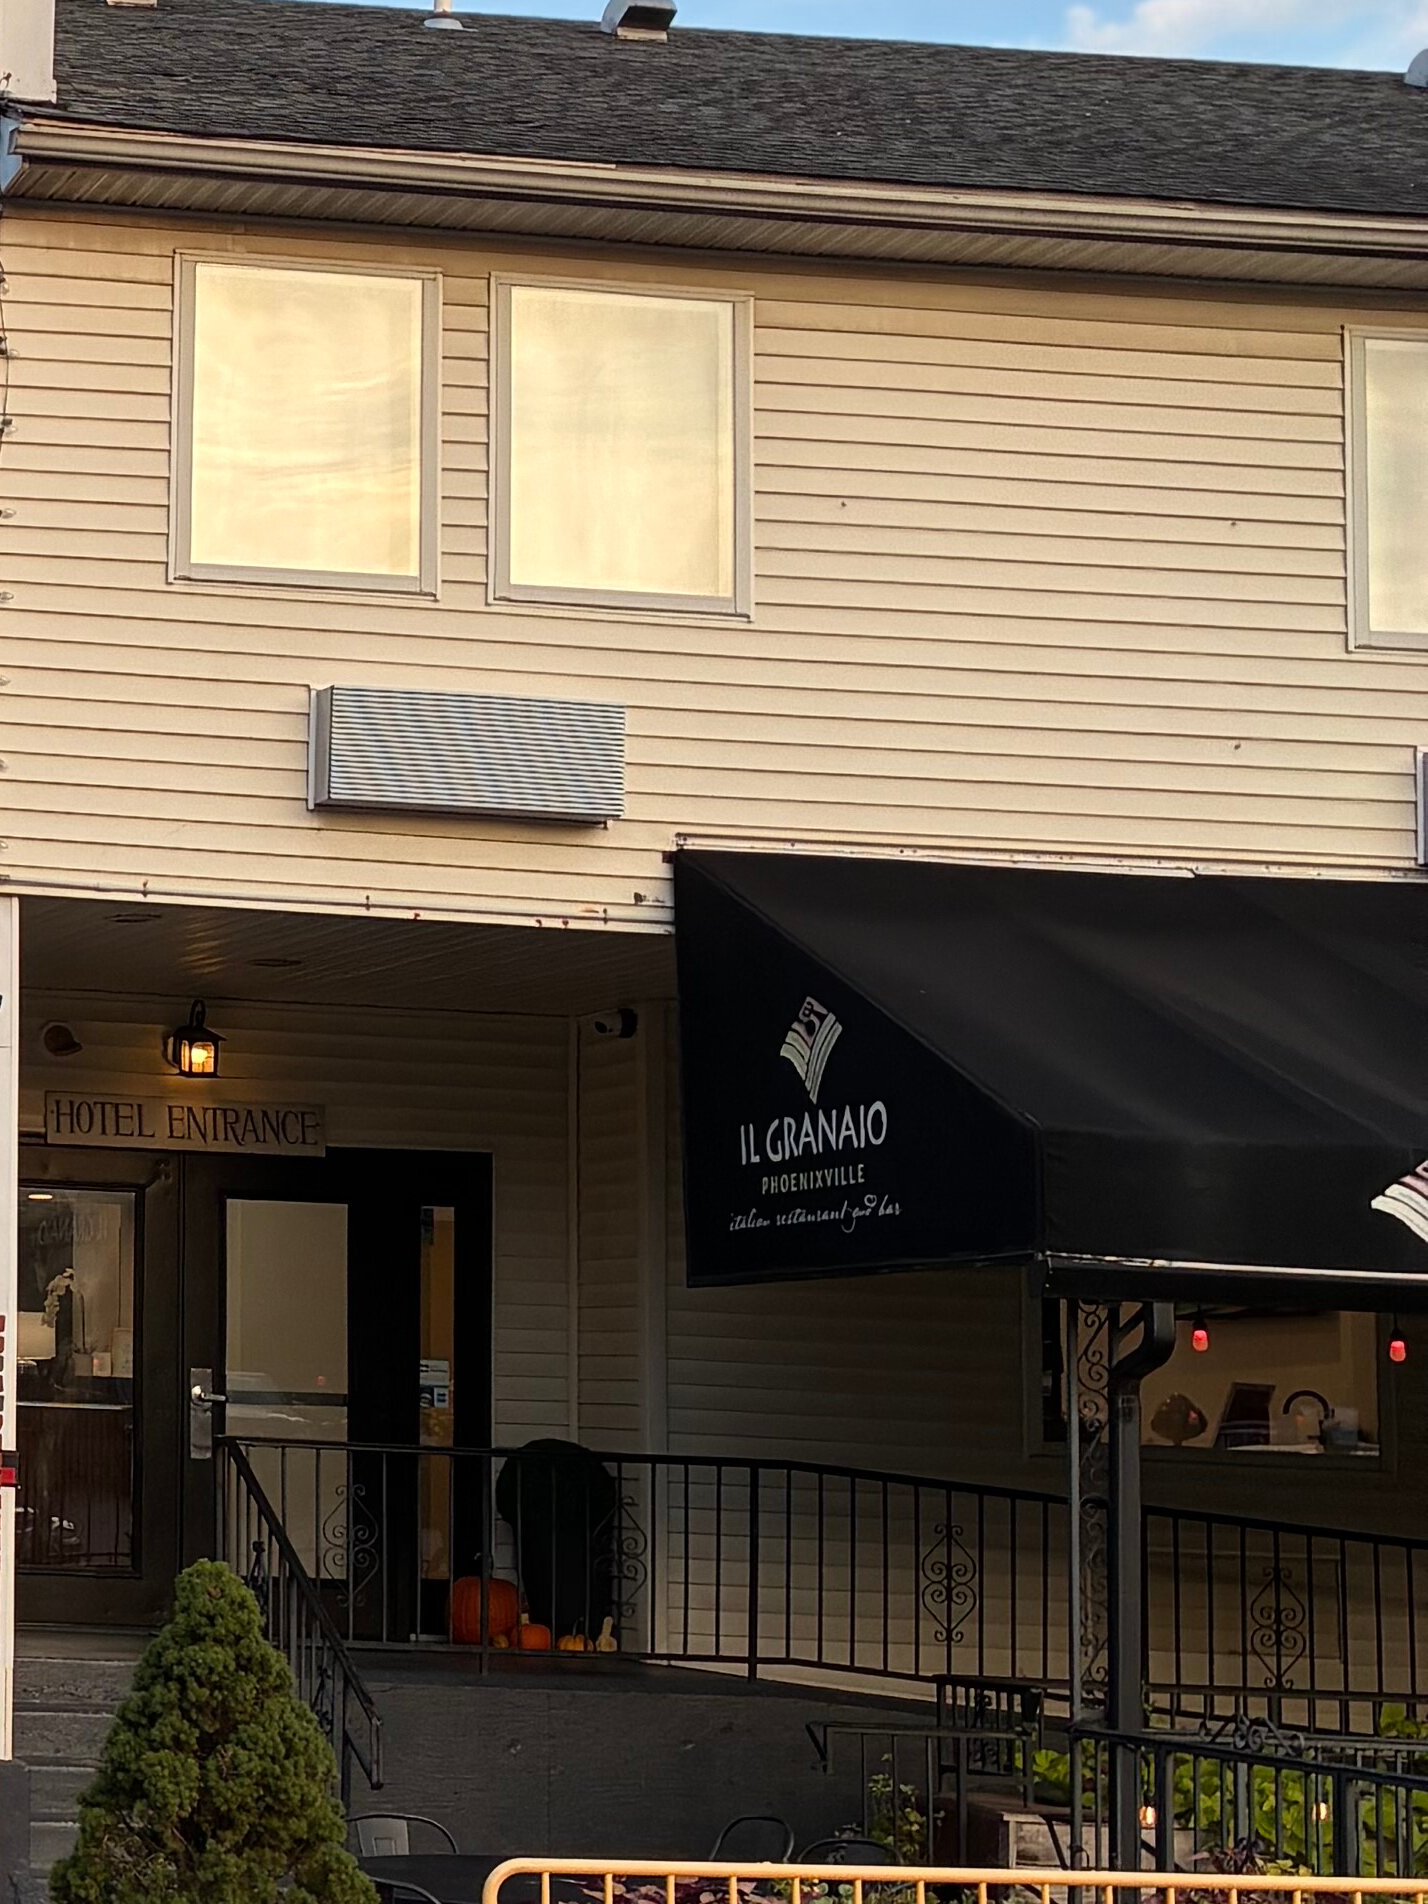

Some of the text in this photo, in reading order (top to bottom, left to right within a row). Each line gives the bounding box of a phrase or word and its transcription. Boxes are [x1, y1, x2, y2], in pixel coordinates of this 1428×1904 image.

[53, 1099, 319, 1146] HOTEL ENTRANCE
[740, 1100, 887, 1165] IL GRANAIO
[762, 1164, 865, 1195] PHOENIXVILLE
[729, 1194, 901, 1233] italian restaurant and bar
